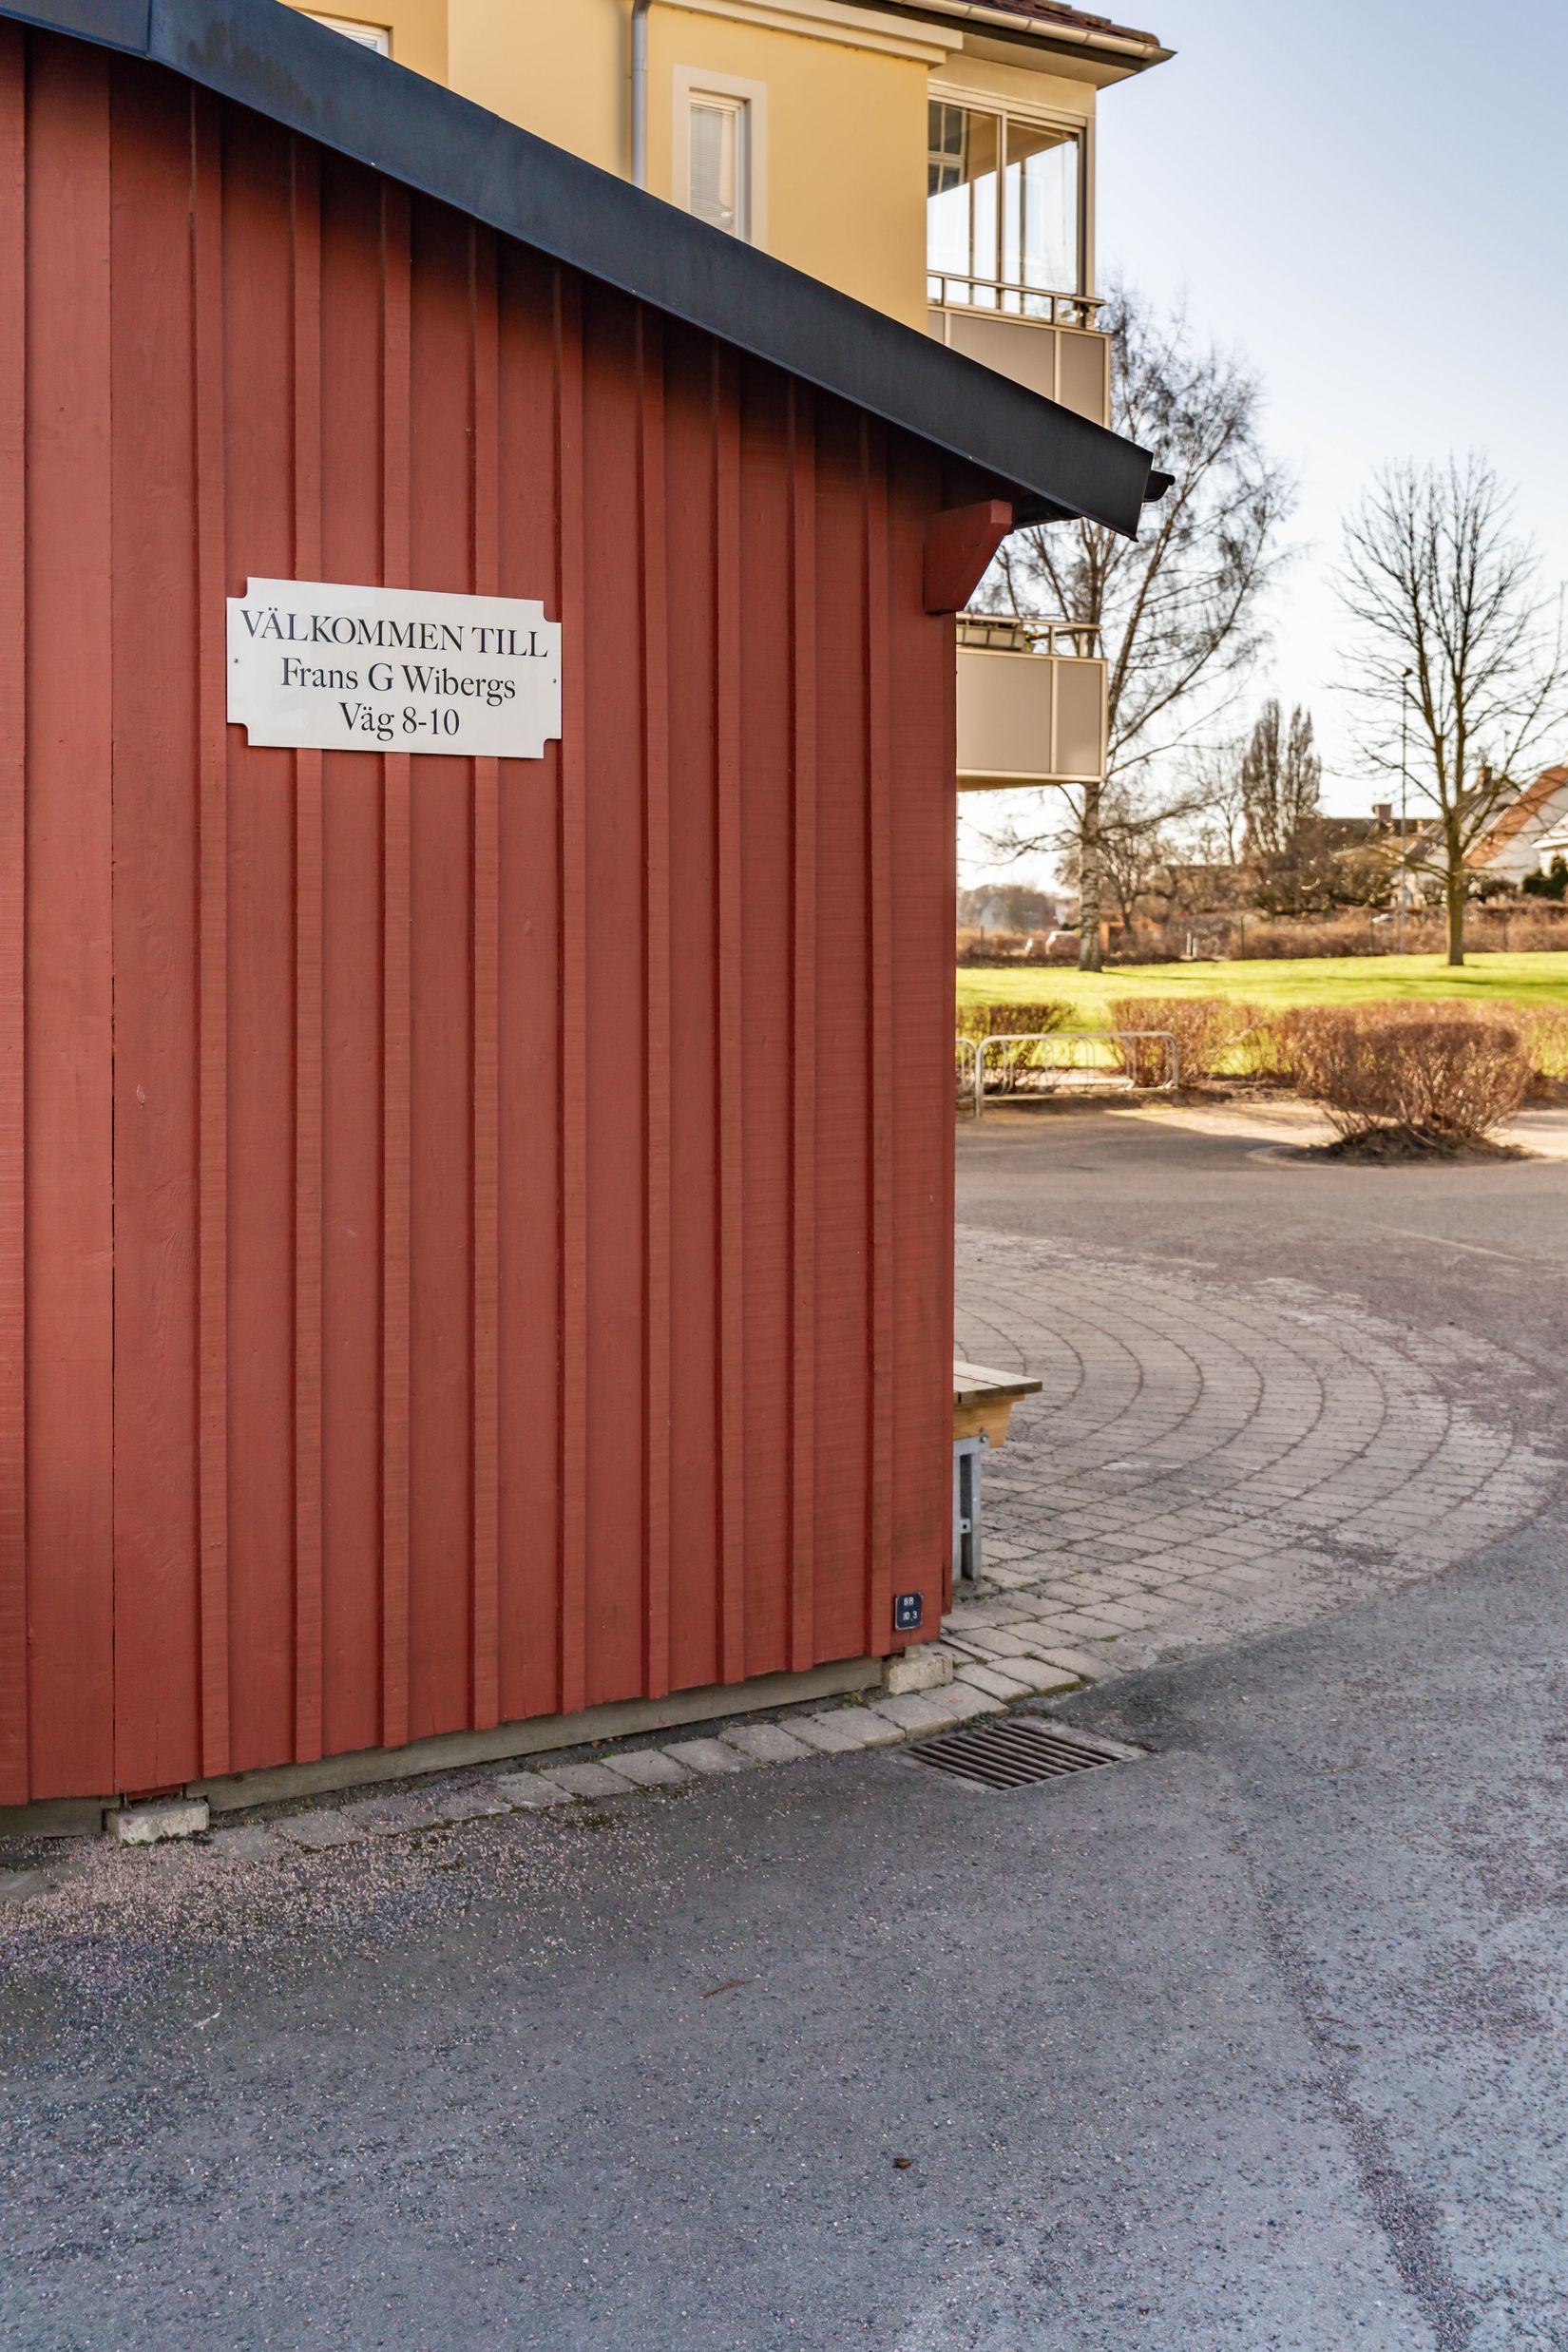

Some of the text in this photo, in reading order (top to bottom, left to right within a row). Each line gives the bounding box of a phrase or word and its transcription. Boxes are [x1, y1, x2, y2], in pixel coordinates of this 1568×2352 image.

[240, 606, 548, 658] VÄLKOMMEN TILL
[280, 657, 516, 707] Frans G Wibergs
[338, 701, 460, 741] Väg 8-10
